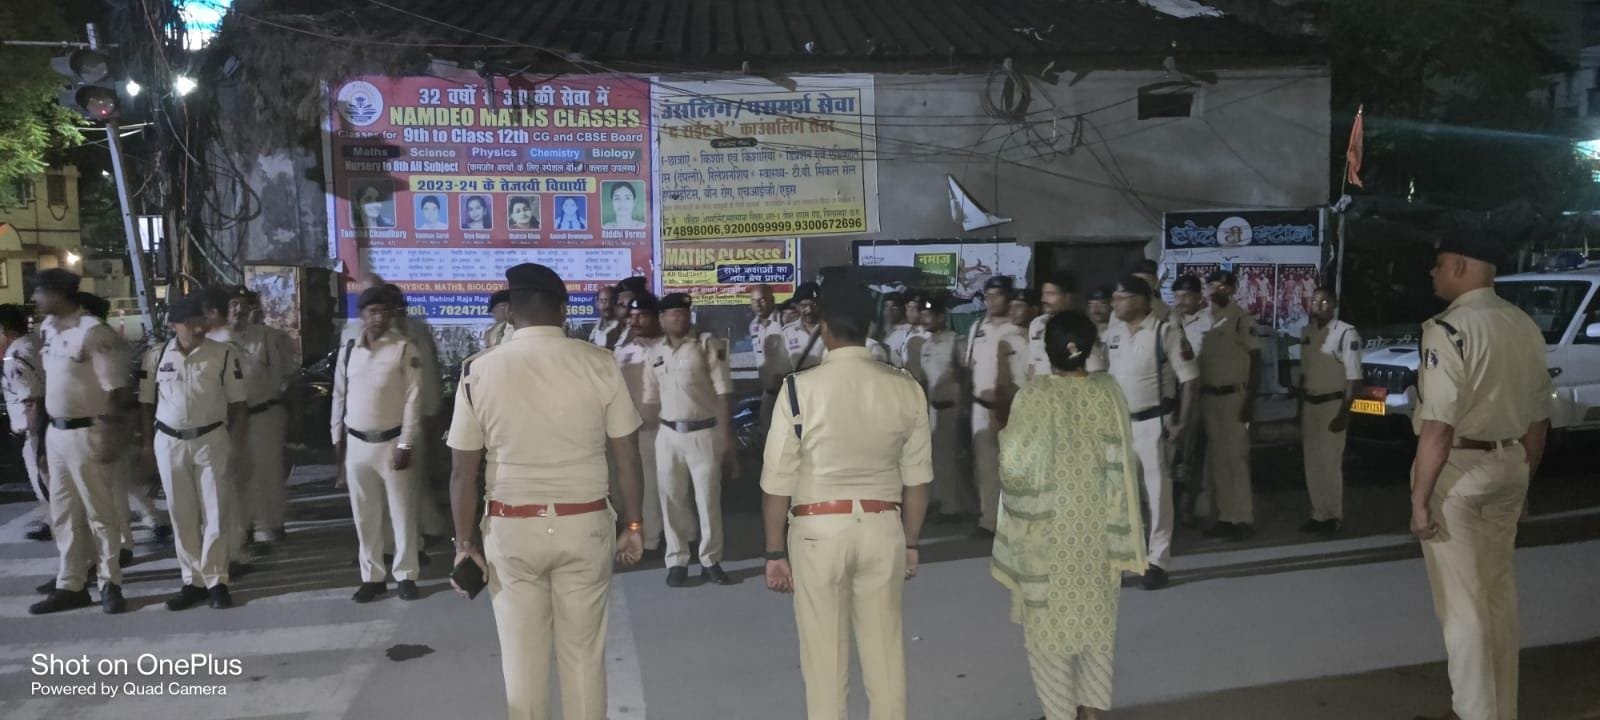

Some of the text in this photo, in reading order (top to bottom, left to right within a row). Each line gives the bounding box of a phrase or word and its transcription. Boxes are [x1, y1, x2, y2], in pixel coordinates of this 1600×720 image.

[419, 88, 441, 104] 32
[447, 83, 478, 105] वर्षों
[560, 86, 591, 106] सेवा
[597, 85, 611, 106] में
[817, 92, 855, 114] सेवा
[390, 106, 475, 127] NAMDEO
[557, 108, 641, 128] CLASSES
[383, 130, 398, 140] for
[403, 127, 429, 143] 9th
[432, 129, 448, 143] to
[451, 128, 493, 144] Class
[497, 128, 529, 144] 12th
[533, 132, 550, 142] CG
[553, 132, 573, 142] and
[577, 132, 607, 142] CBSE
[611, 132, 643, 142] Board
[353, 147, 636, 160] Maths Science Physics Chemistry Biology
[345, 161, 458, 173] Nursery to 8th All Subject
[517, 162, 525, 172] के
[526, 162, 540, 173] लिए
[417, 178, 588, 192] 2023-24 के तेजस्वी विद्यार्थी
[664, 247, 715, 267] MATHS
[718, 248, 781, 261] CLASSES
[776, 265, 788, 273] का
[430, 295, 454, 303] Behind
[456, 295, 473, 303] Raja
[439, 305, 489, 316] 7024712
[566, 305, 594, 315] 5699
